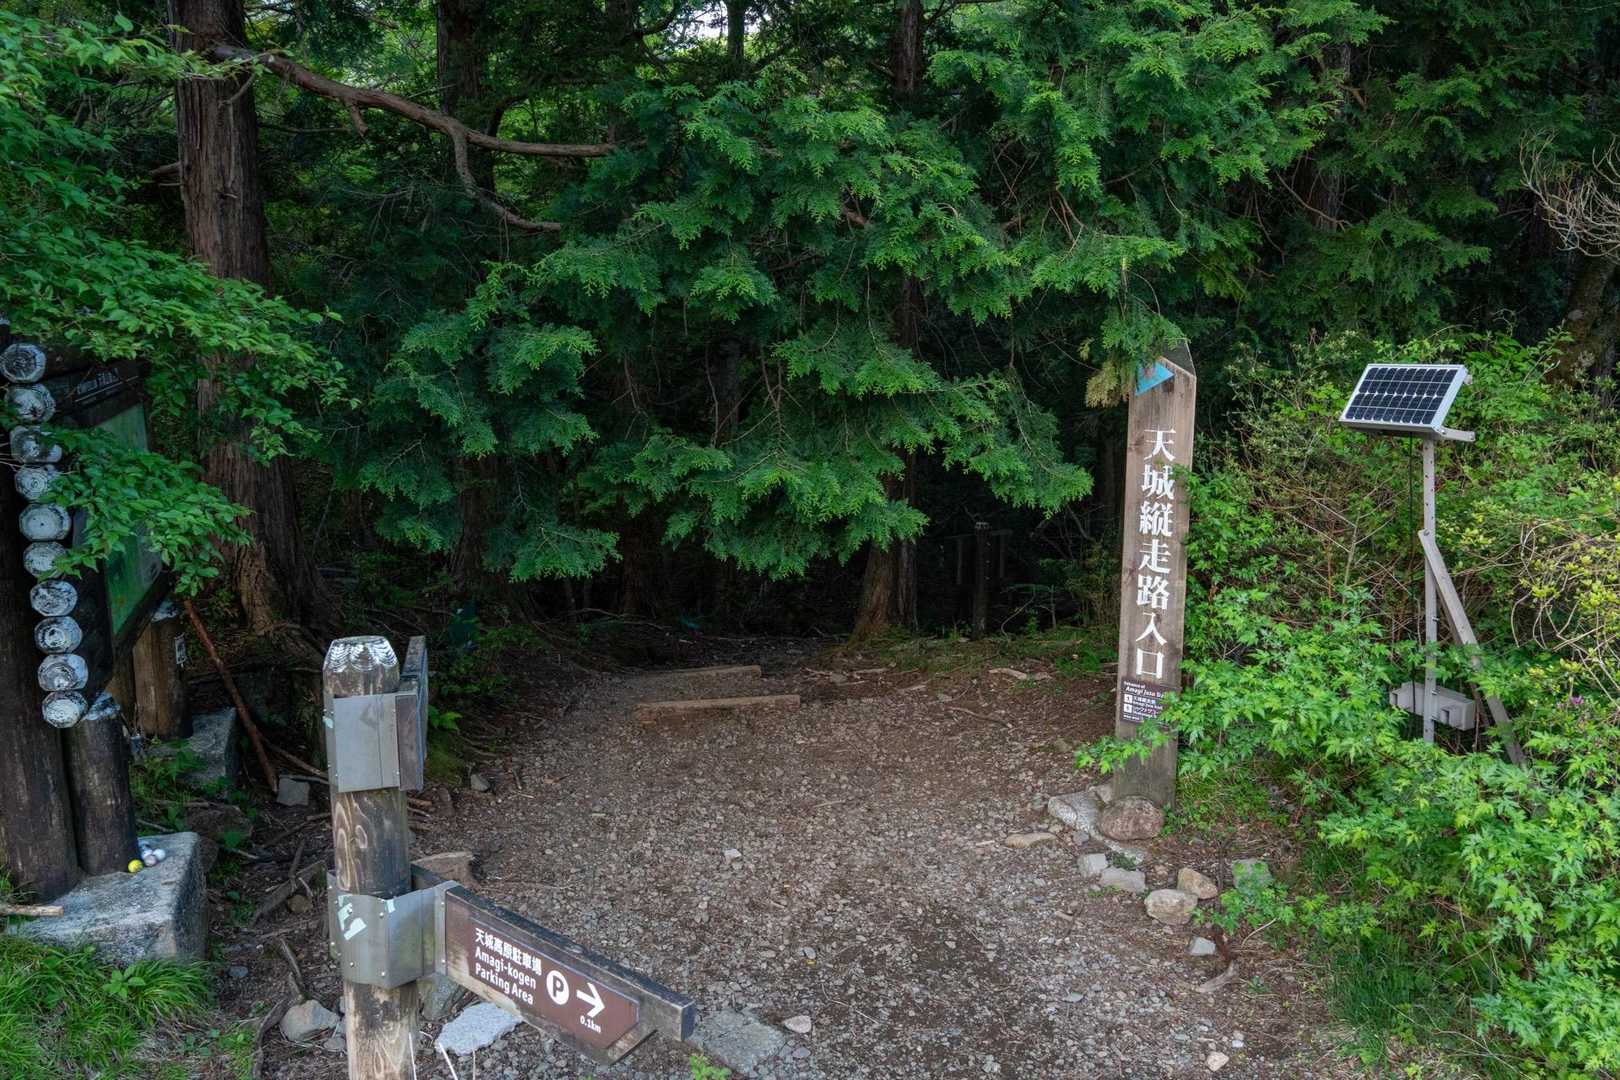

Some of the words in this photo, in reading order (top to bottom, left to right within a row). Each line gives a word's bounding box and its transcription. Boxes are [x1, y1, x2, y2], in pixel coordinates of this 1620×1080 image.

[1135, 428, 1177, 679] 天城縦走路入口
[475, 928, 542, 976] 天城高原駐車場
[475, 949, 536, 990] Amagi-kogen
[475, 963, 510, 993] Parking
[512, 984, 534, 1005] Area
[580, 1015, 602, 1033] 0.1km
